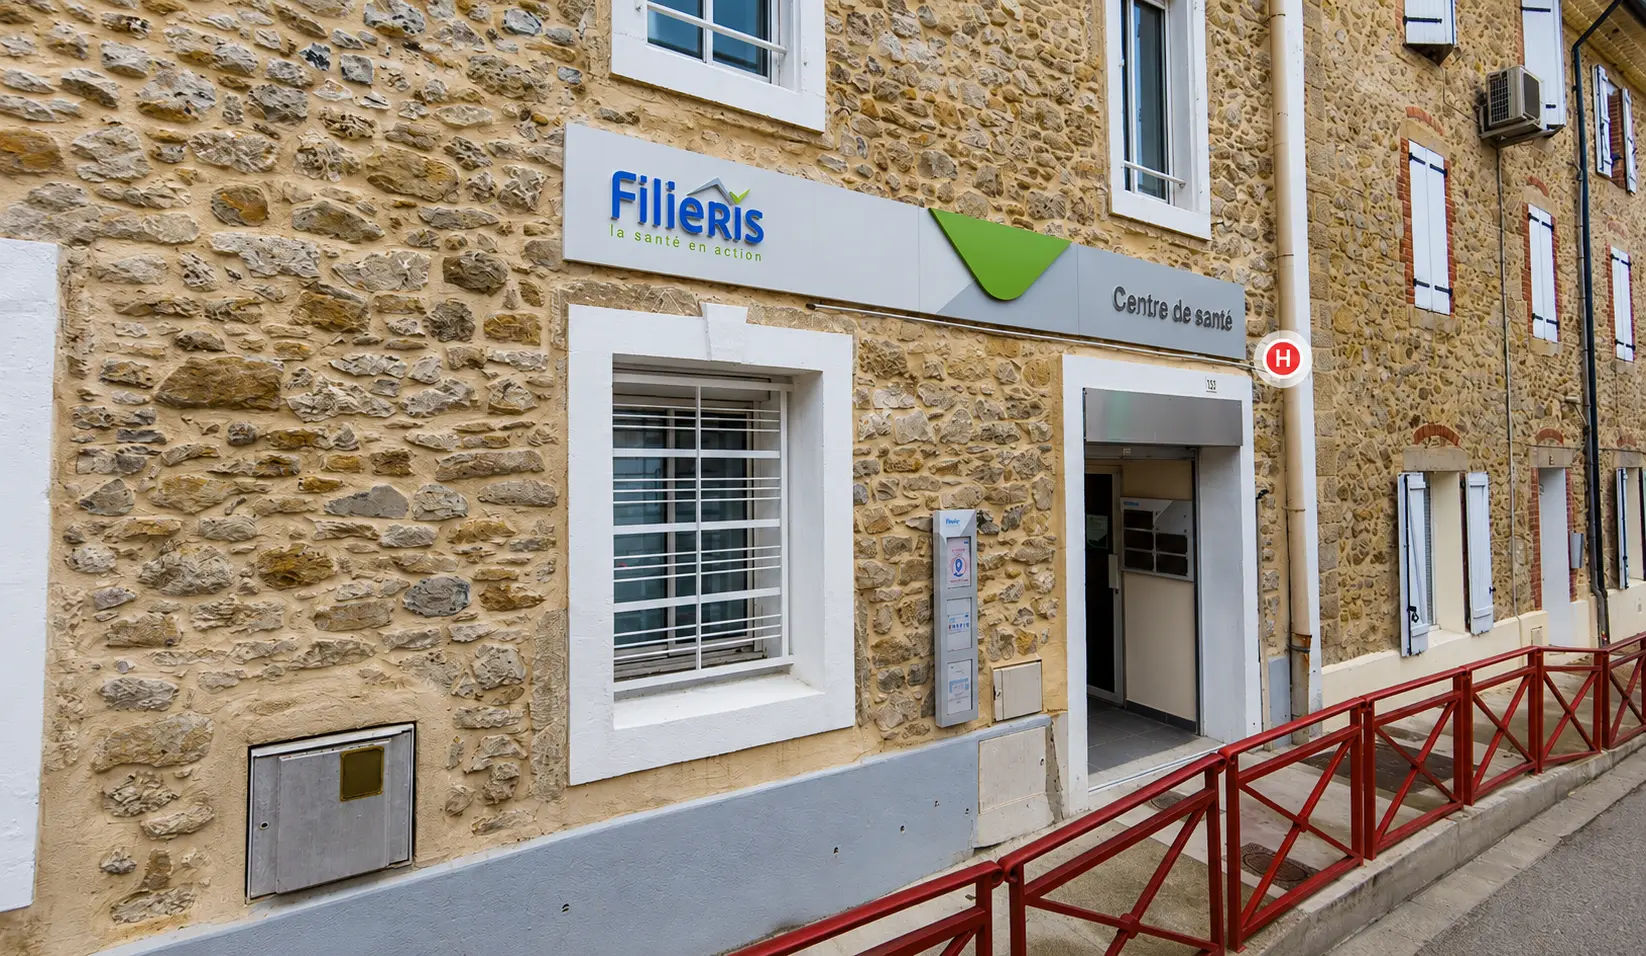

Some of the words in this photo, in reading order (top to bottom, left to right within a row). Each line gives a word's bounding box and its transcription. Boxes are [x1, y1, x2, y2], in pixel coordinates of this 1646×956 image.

[610, 223, 625, 238] la
[634, 231, 681, 248] santé
[689, 241, 706, 253] en
[714, 245, 762, 262] action
[1112, 286, 1169, 320] Centre
[1172, 299, 1191, 324] de
[1195, 308, 1233, 332] santé
